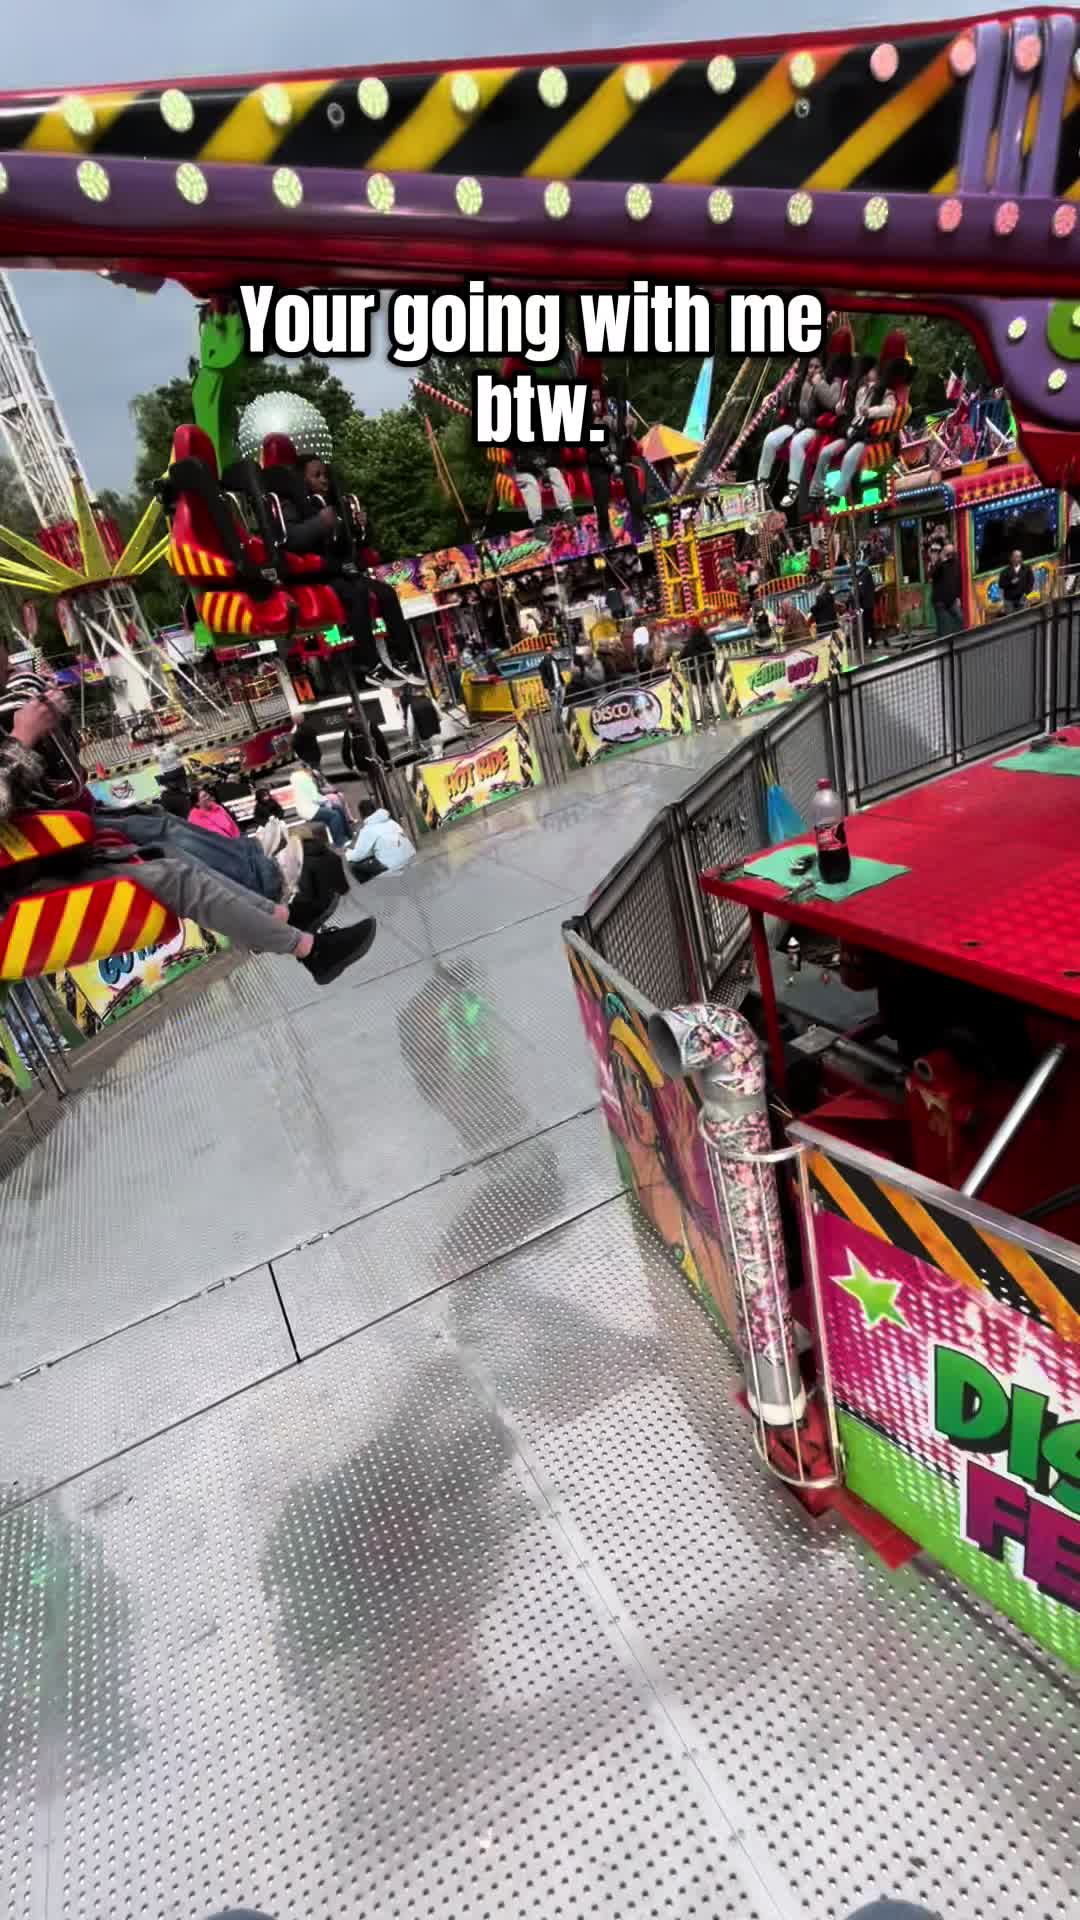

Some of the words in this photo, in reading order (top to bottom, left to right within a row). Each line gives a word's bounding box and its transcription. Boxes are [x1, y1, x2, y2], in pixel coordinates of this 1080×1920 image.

[592, 702, 632, 723] DISCO
[447, 762, 476, 800] HOT
[476, 746, 510, 782] RIDE
